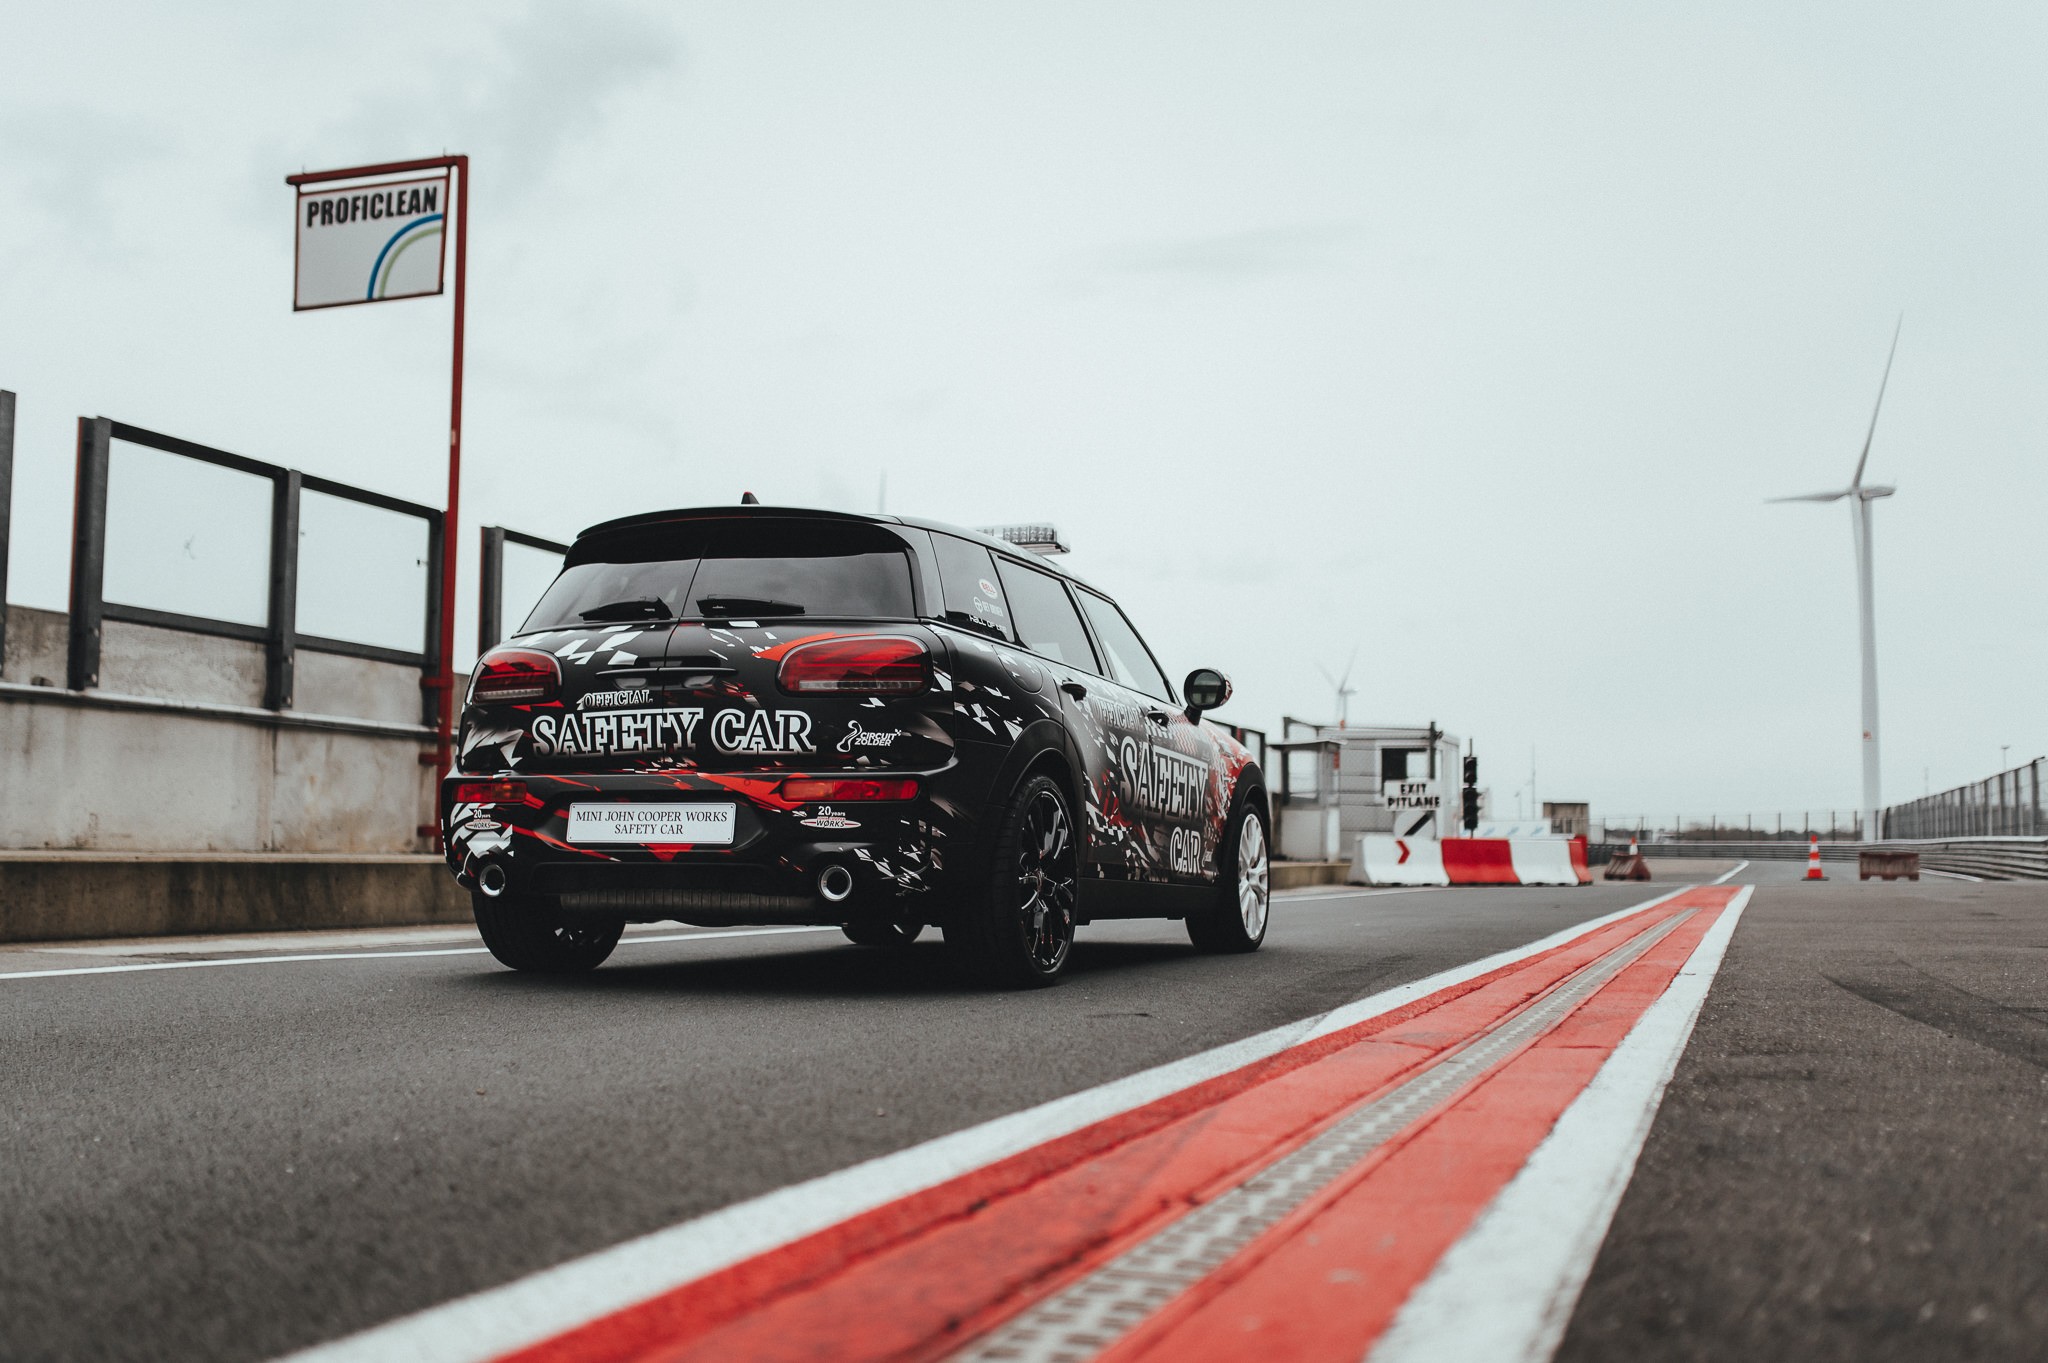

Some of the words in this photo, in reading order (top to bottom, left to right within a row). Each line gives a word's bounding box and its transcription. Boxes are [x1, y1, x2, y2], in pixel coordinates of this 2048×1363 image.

[307, 186, 437, 228] PROFICLEAN
[583, 689, 653, 707] OFFICIAL
[532, 707, 704, 758] SAFETY
[710, 708, 818, 756] CAR
[860, 731, 897, 741] CIRCUIT
[854, 737, 892, 747] ZOLDER
[1120, 735, 1208, 820] SAFETY
[1400, 783, 1427, 796] EXIT
[1387, 796, 1440, 808] PITLANE
[576, 811, 602, 822] MINI
[604, 811, 635, 822] JOHN
[637, 811, 682, 822] COOPER
[686, 811, 728, 822] WORKS
[614, 823, 657, 835] SAFETY
[660, 824, 684, 835] CAR
[816, 820, 845, 828] WORKS
[1169, 826, 1201, 874] CAR
